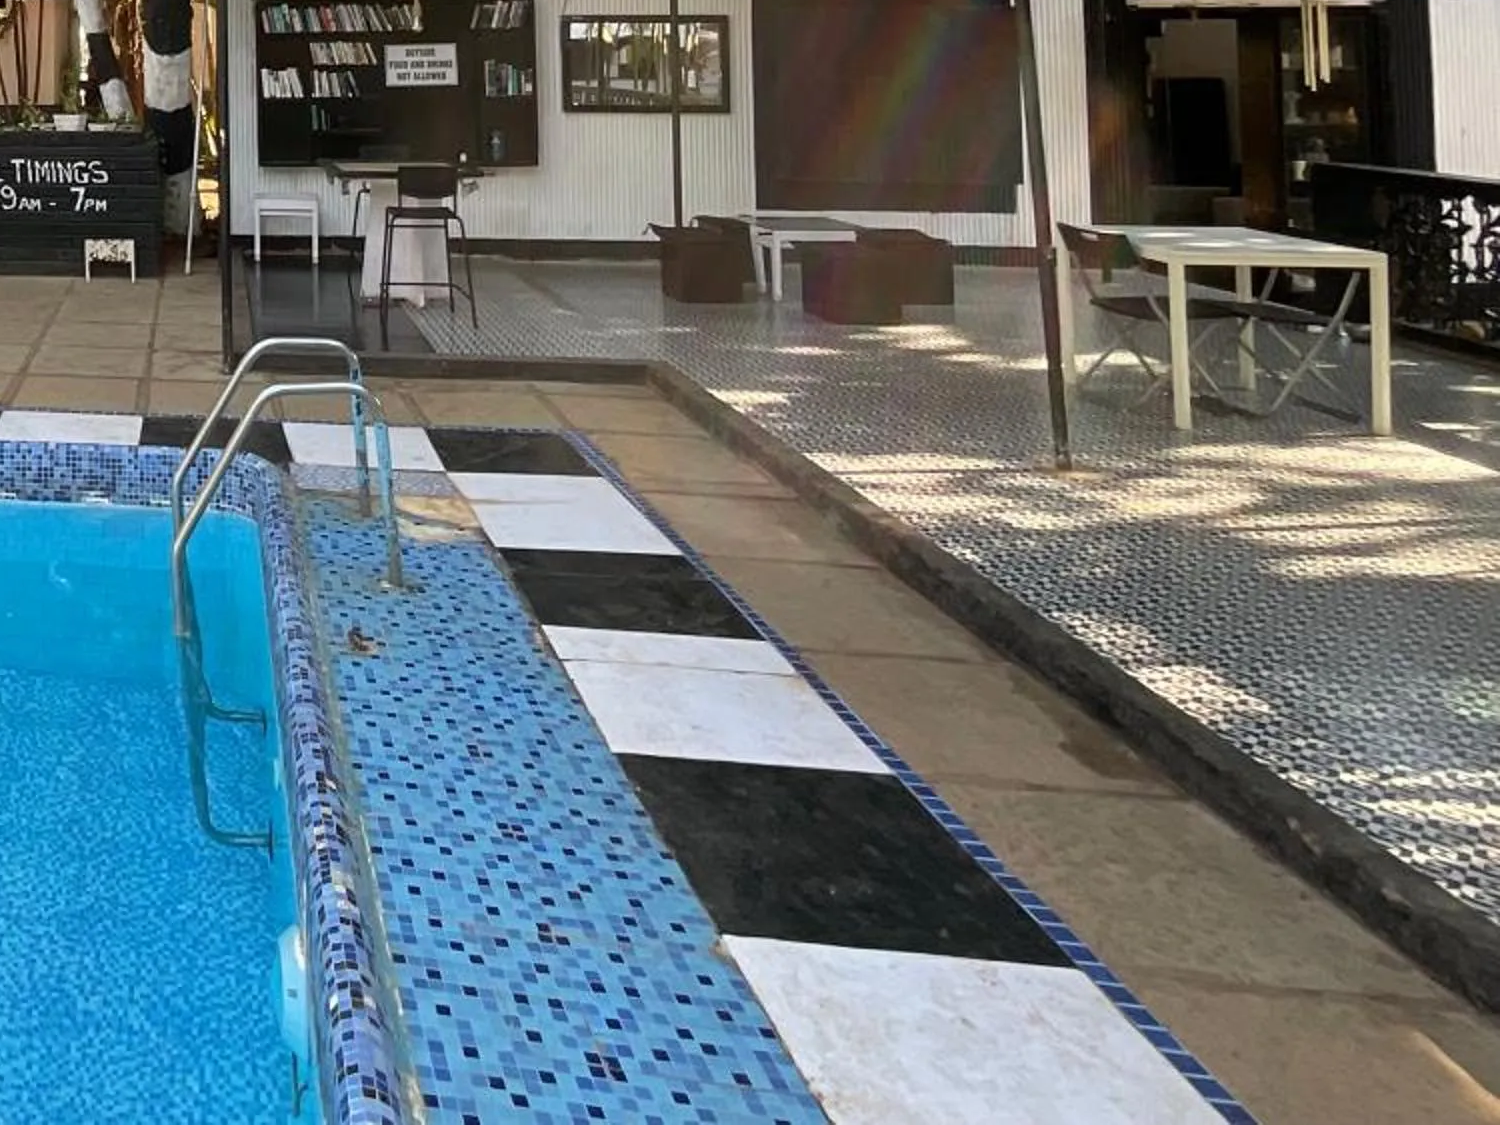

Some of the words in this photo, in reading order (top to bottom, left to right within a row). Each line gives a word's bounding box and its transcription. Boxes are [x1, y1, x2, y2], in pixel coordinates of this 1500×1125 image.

[10, 158, 109, 184] TIMINGS
[0, 184, 42, 212] 9AM
[69, 186, 108, 212] 7PM
